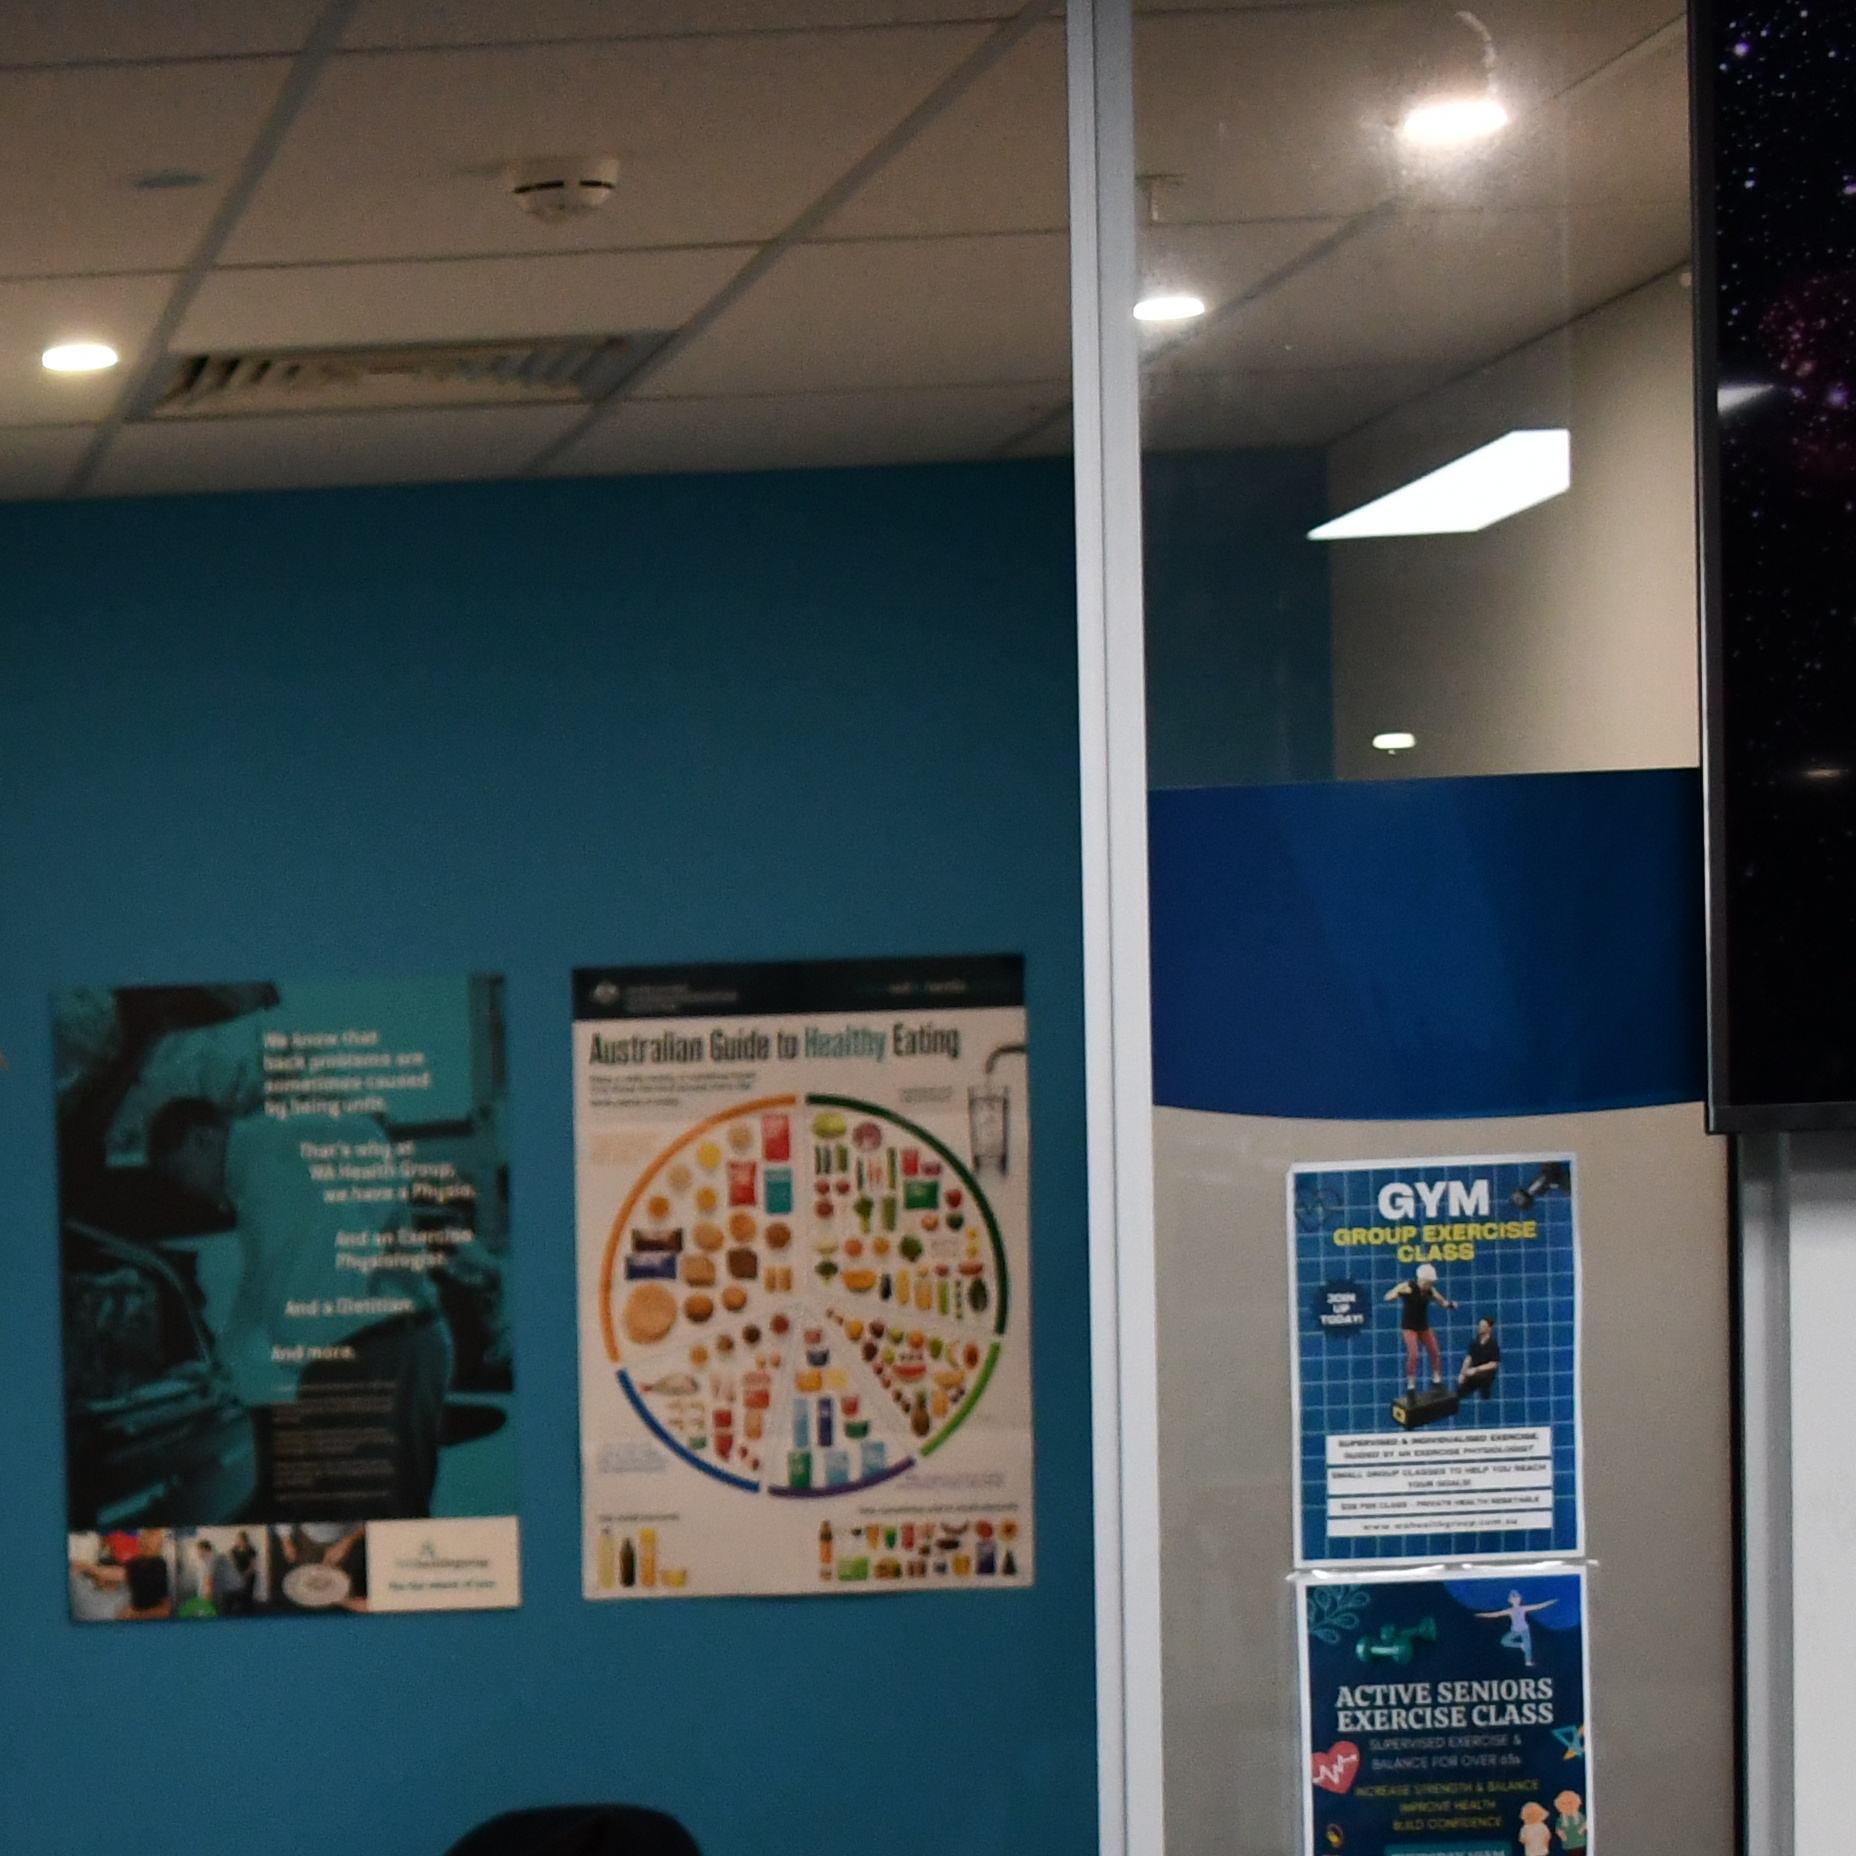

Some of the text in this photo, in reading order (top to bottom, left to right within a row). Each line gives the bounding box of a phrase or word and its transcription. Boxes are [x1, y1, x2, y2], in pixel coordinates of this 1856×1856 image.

[343, 1031, 377, 1045] that
[590, 1020, 961, 1065] Australian Guide to Healthy Eating
[1378, 1179, 1490, 1220] GYM
[336, 1231, 368, 1246] And
[398, 1228, 474, 1244] Exercise
[1333, 1221, 1537, 1247] GROUP EXERCISE
[1397, 1243, 1475, 1263] CLASS
[1327, 1292, 1356, 1304] JOIN
[286, 1300, 320, 1316] And
[1333, 1303, 1350, 1314] UP
[1319, 1313, 1364, 1326] TODAY!
[272, 1346, 304, 1361] And
[1336, 1677, 1553, 1708] ACTIVE SENIORS
[1337, 1702, 1554, 1732] EXERCISE CLASS
[1370, 1734, 1522, 1750] SUPERVISED EXERCISE &
[1372, 1756, 1428, 1770] BALANCE
[1432, 1755, 1458, 1768] FOR
[1460, 1753, 1496, 1767] OVER
